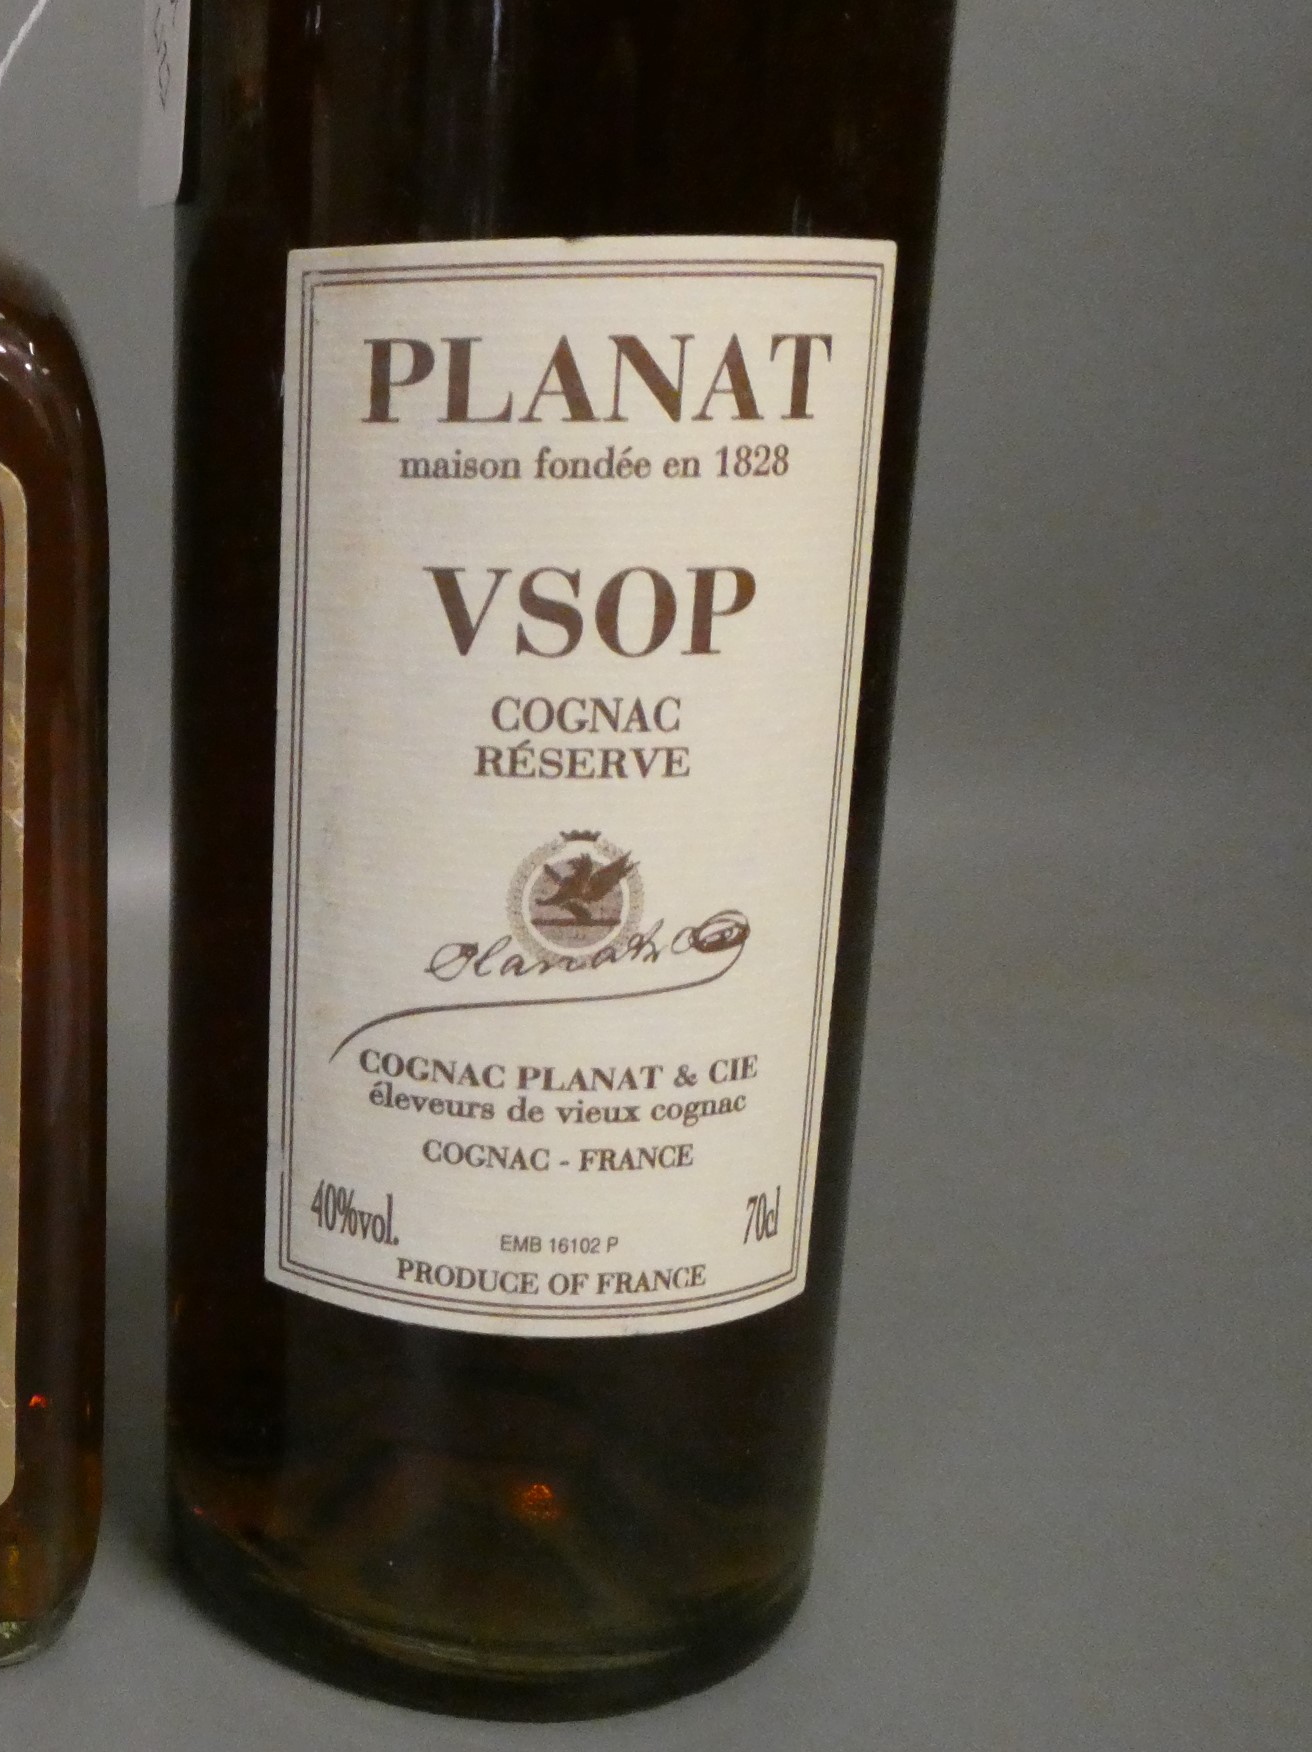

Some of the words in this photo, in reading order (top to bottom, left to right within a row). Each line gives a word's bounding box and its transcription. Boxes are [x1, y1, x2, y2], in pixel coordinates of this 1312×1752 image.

[360, 332, 833, 425] PLANAT
[399, 449, 522, 481] maison
[534, 444, 652, 480] fondée
[662, 456, 701, 479] en
[714, 444, 790, 479] 1828
[422, 565, 757, 659] VSOP
[491, 695, 682, 734] COGNAC
[473, 739, 691, 779] RÉSERVE
[358, 1048, 505, 1089] COGNAC
[516, 1065, 664, 1091] PLANAT
[672, 1064, 698, 1087] &
[707, 1053, 759, 1083] CIE
[367, 1080, 495, 1123] éleveurs
[506, 1096, 545, 1123] de
[555, 1101, 640, 1125] vieux
[650, 1092, 748, 1127] cognac
[421, 1137, 550, 1171] COGNAC
[579, 1143, 695, 1173] FRANCE
[742, 1184, 782, 1245] 70cl
[500, 1235, 542, 1253] EMB
[548, 1235, 601, 1254] 16102
[606, 1236, 619, 1253] P
[396, 1257, 539, 1295] PRODUCE
[548, 1272, 587, 1296] OF
[595, 1263, 707, 1295] FRANCE
